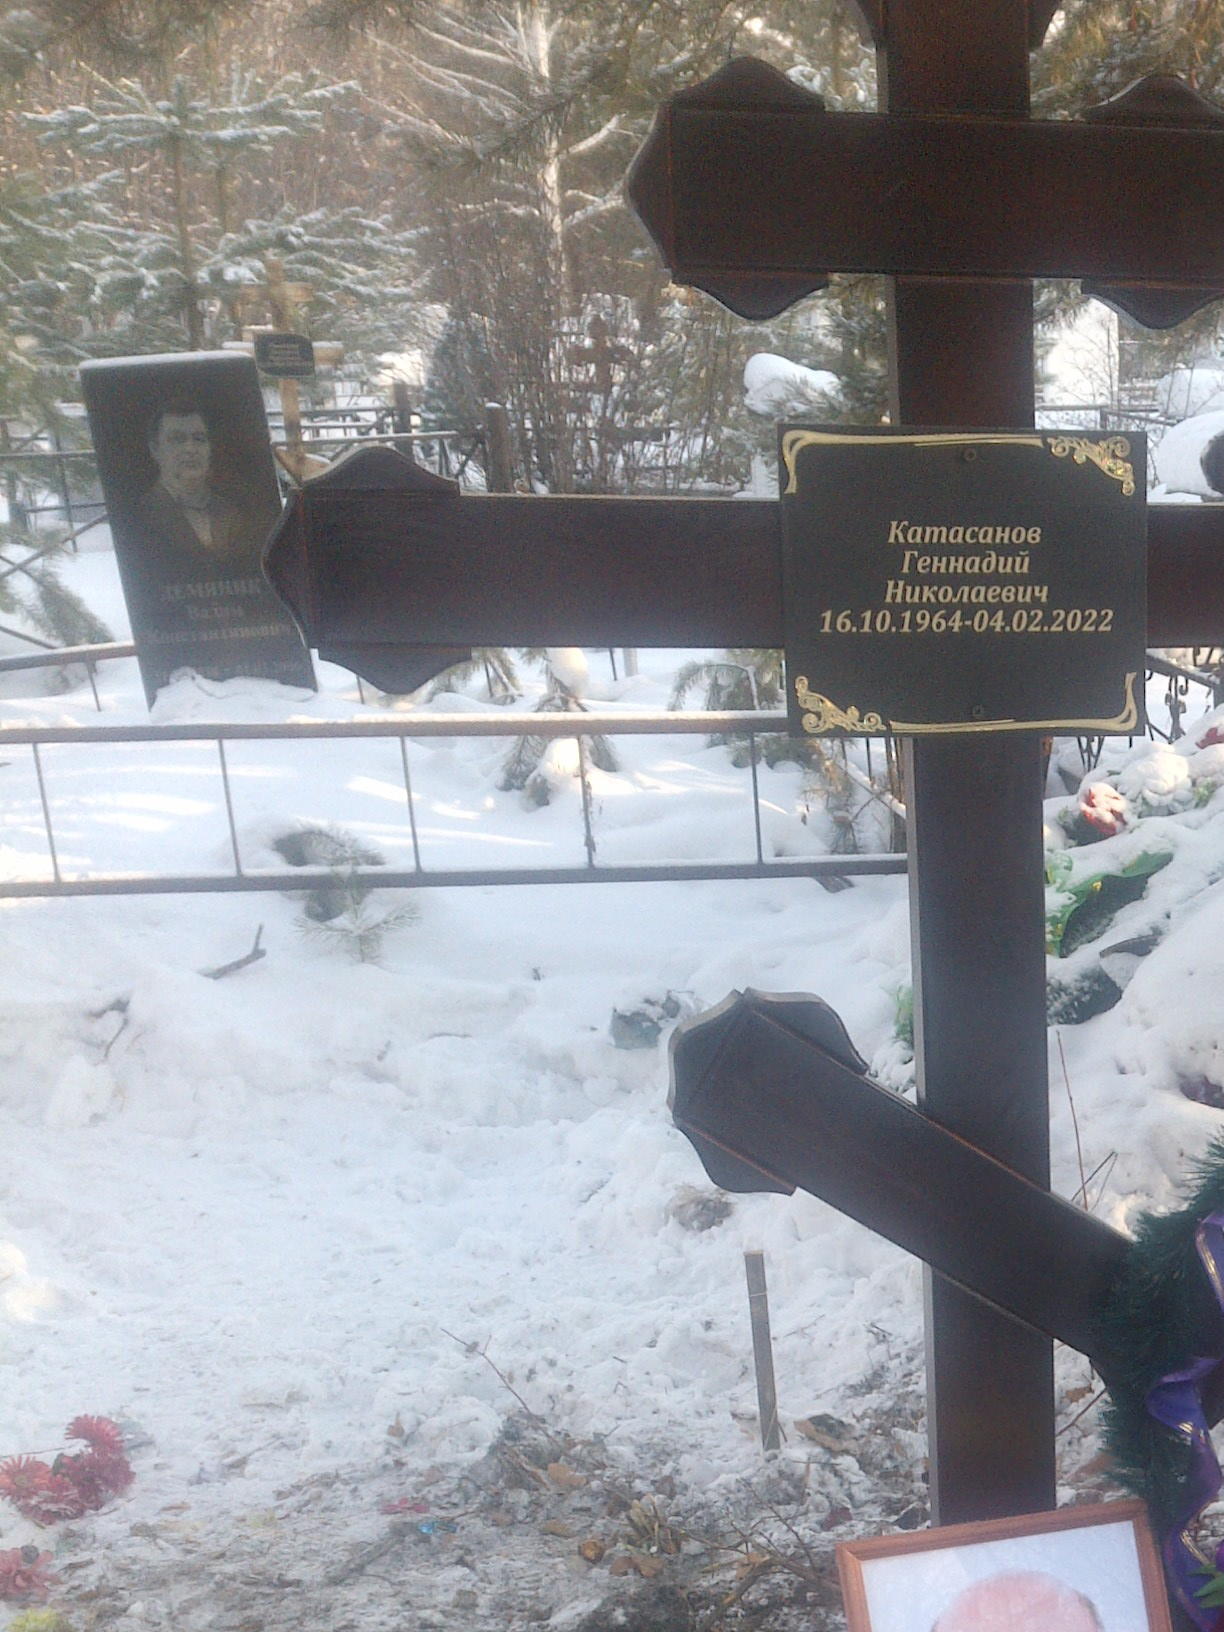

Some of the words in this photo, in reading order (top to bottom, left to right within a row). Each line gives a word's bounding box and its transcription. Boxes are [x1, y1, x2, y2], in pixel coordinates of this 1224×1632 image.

[887, 520, 1042, 545] Катасанов
[901, 550, 1030, 575] Геннадий
[884, 579, 1049, 604] Николаевич
[818, 608, 1114, 634] 16.10.1964-04.02.2022
